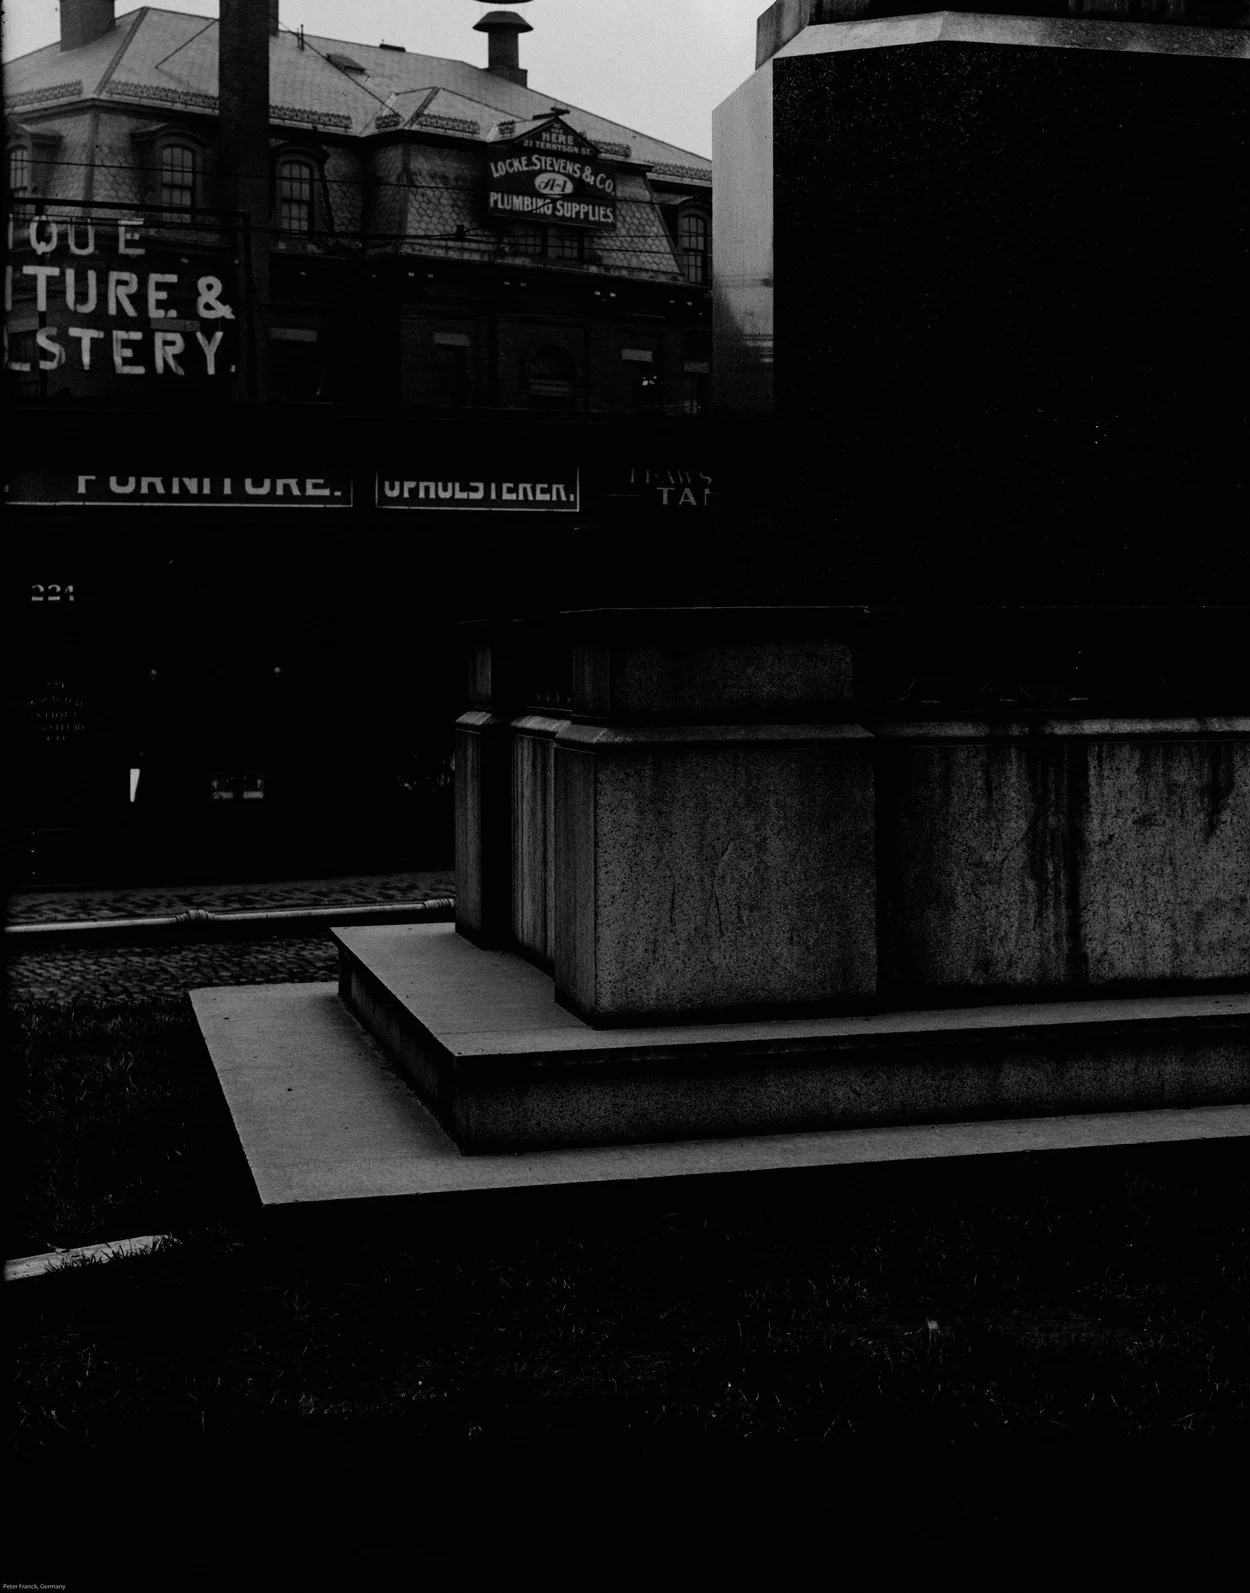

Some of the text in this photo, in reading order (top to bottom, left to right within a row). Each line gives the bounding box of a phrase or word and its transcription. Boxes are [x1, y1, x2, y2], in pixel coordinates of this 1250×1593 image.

[535, 140, 579, 155] TENNYSON
[541, 132, 574, 146] HERE
[531, 154, 582, 178] STEVENS
[582, 165, 595, 185] &
[490, 192, 615, 223] PLUMBING SUPPLIES
[196, 274, 236, 320] &
